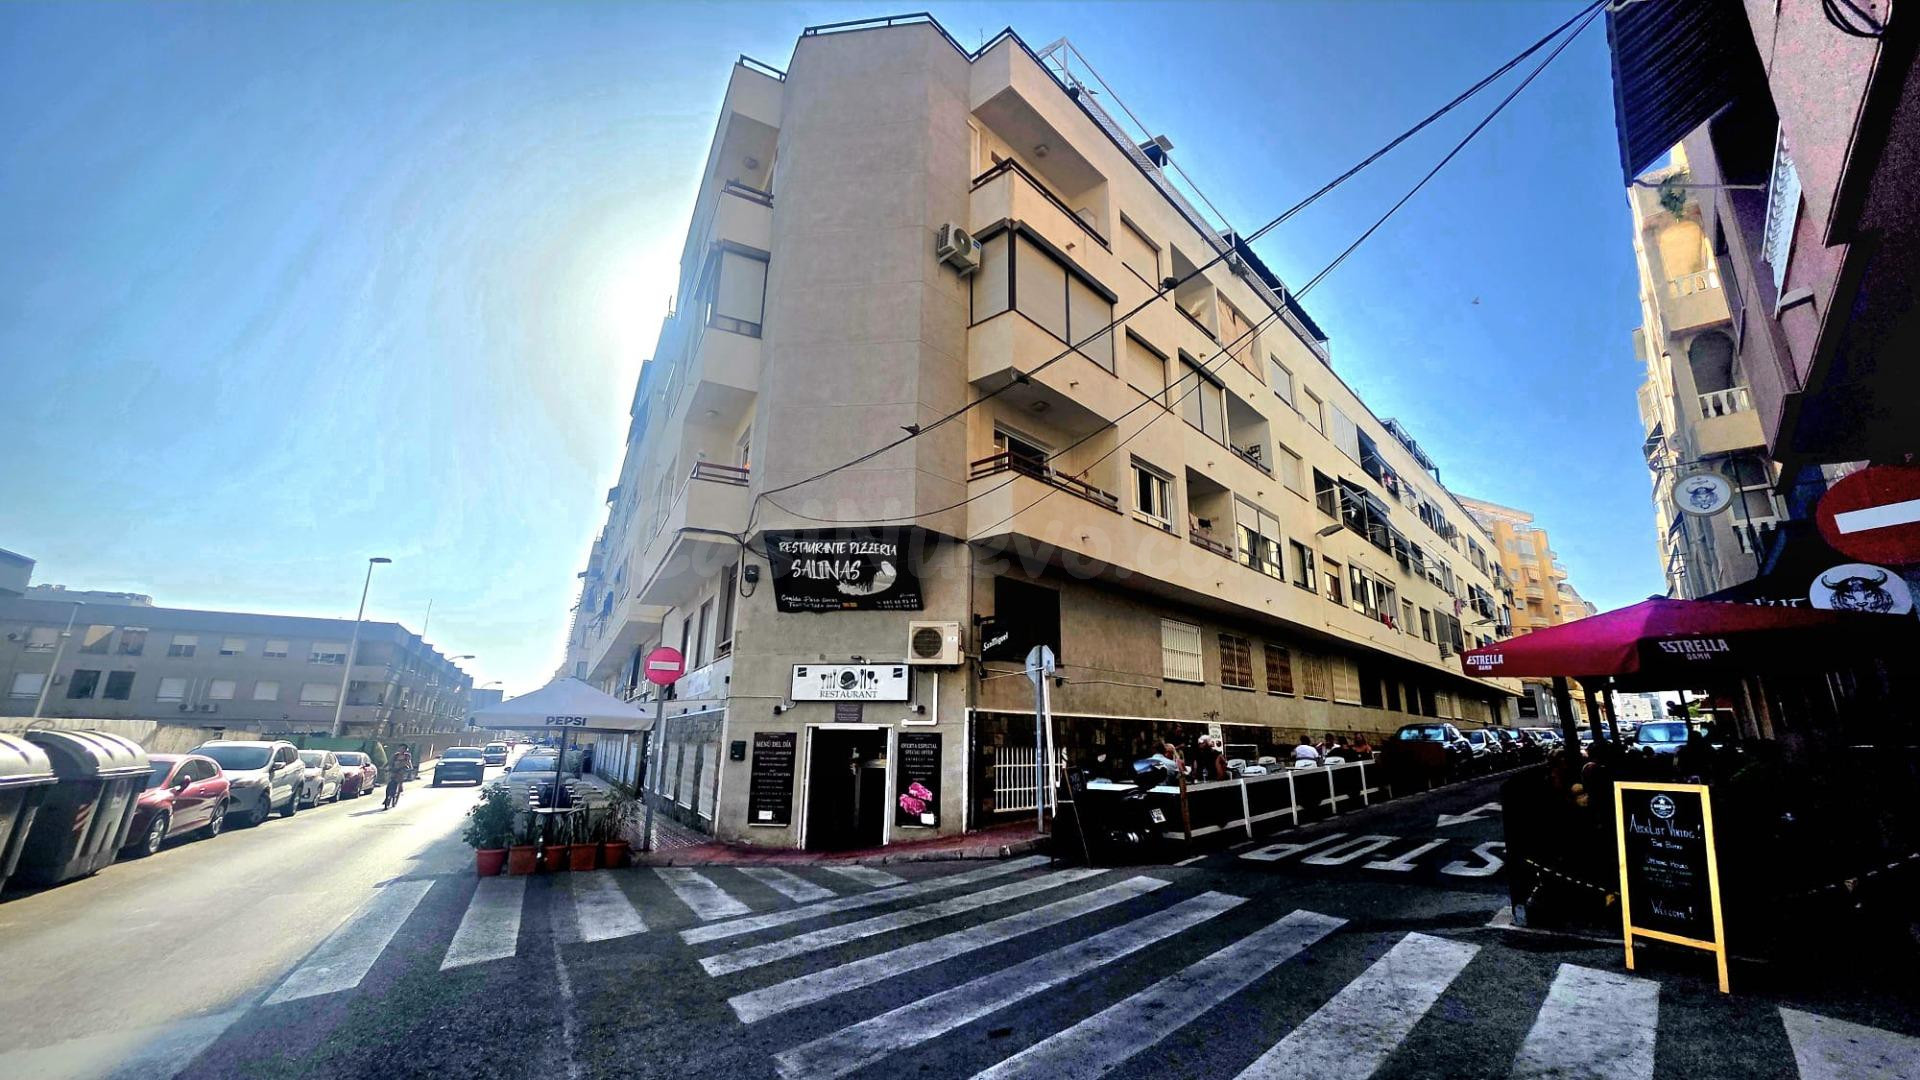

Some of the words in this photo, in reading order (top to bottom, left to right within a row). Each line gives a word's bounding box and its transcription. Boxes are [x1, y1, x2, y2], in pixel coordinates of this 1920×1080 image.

[778, 541, 846, 554] RESTAURANTE
[849, 541, 897, 556] PIZZERIA
[791, 559, 861, 580] SALINAS
[1658, 638, 1730, 653] ESTRELLA
[1466, 654, 1504, 665] ESTRELLA
[1686, 652, 1711, 661] DAMM
[819, 690, 878, 698] RESTAURANT
[545, 716, 587, 726] PEPSI
[1238, 832, 1507, 878] STOP
